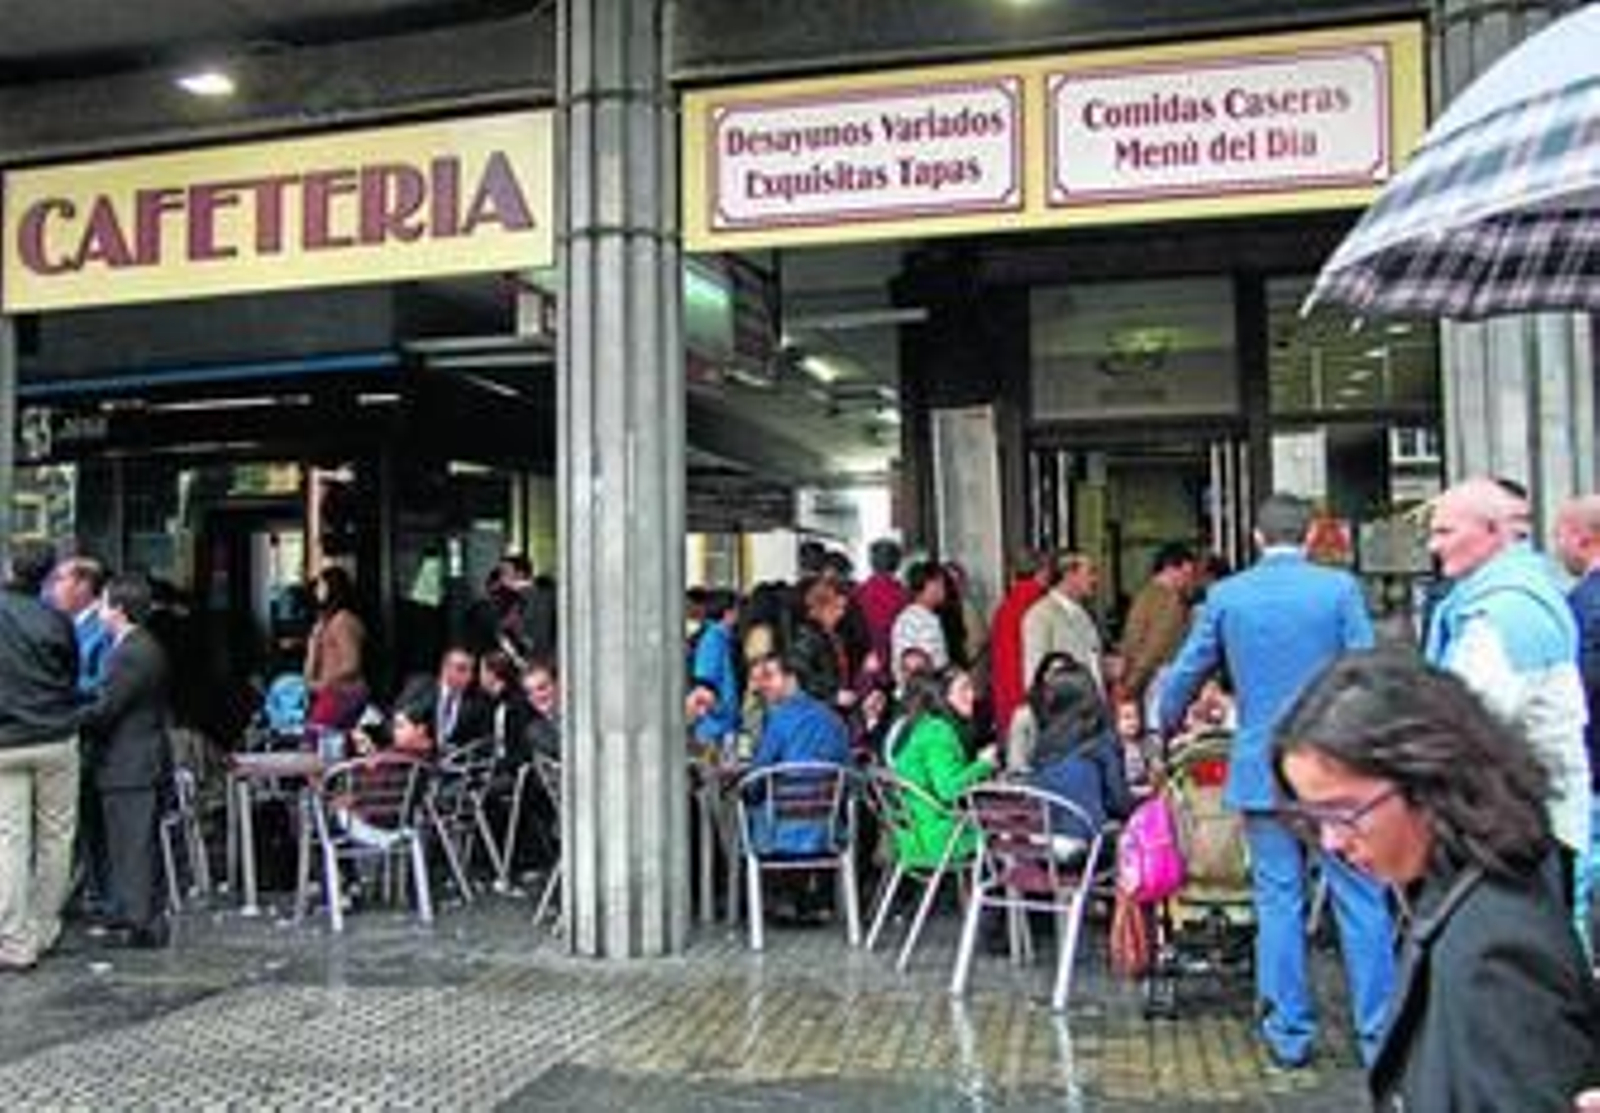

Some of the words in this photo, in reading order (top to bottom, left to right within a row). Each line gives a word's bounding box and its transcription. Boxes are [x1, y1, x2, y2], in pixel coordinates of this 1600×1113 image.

[727, 119, 874, 155] Desayunos
[881, 106, 1005, 142] Variados
[1083, 92, 1216, 131] Comidas
[1224, 85, 1351, 119] Caseras
[1209, 131, 1255, 162] del
[746, 160, 888, 201] Exquisitas
[898, 155, 982, 190] Tapas
[17, 151, 534, 275] CAFETERIA
